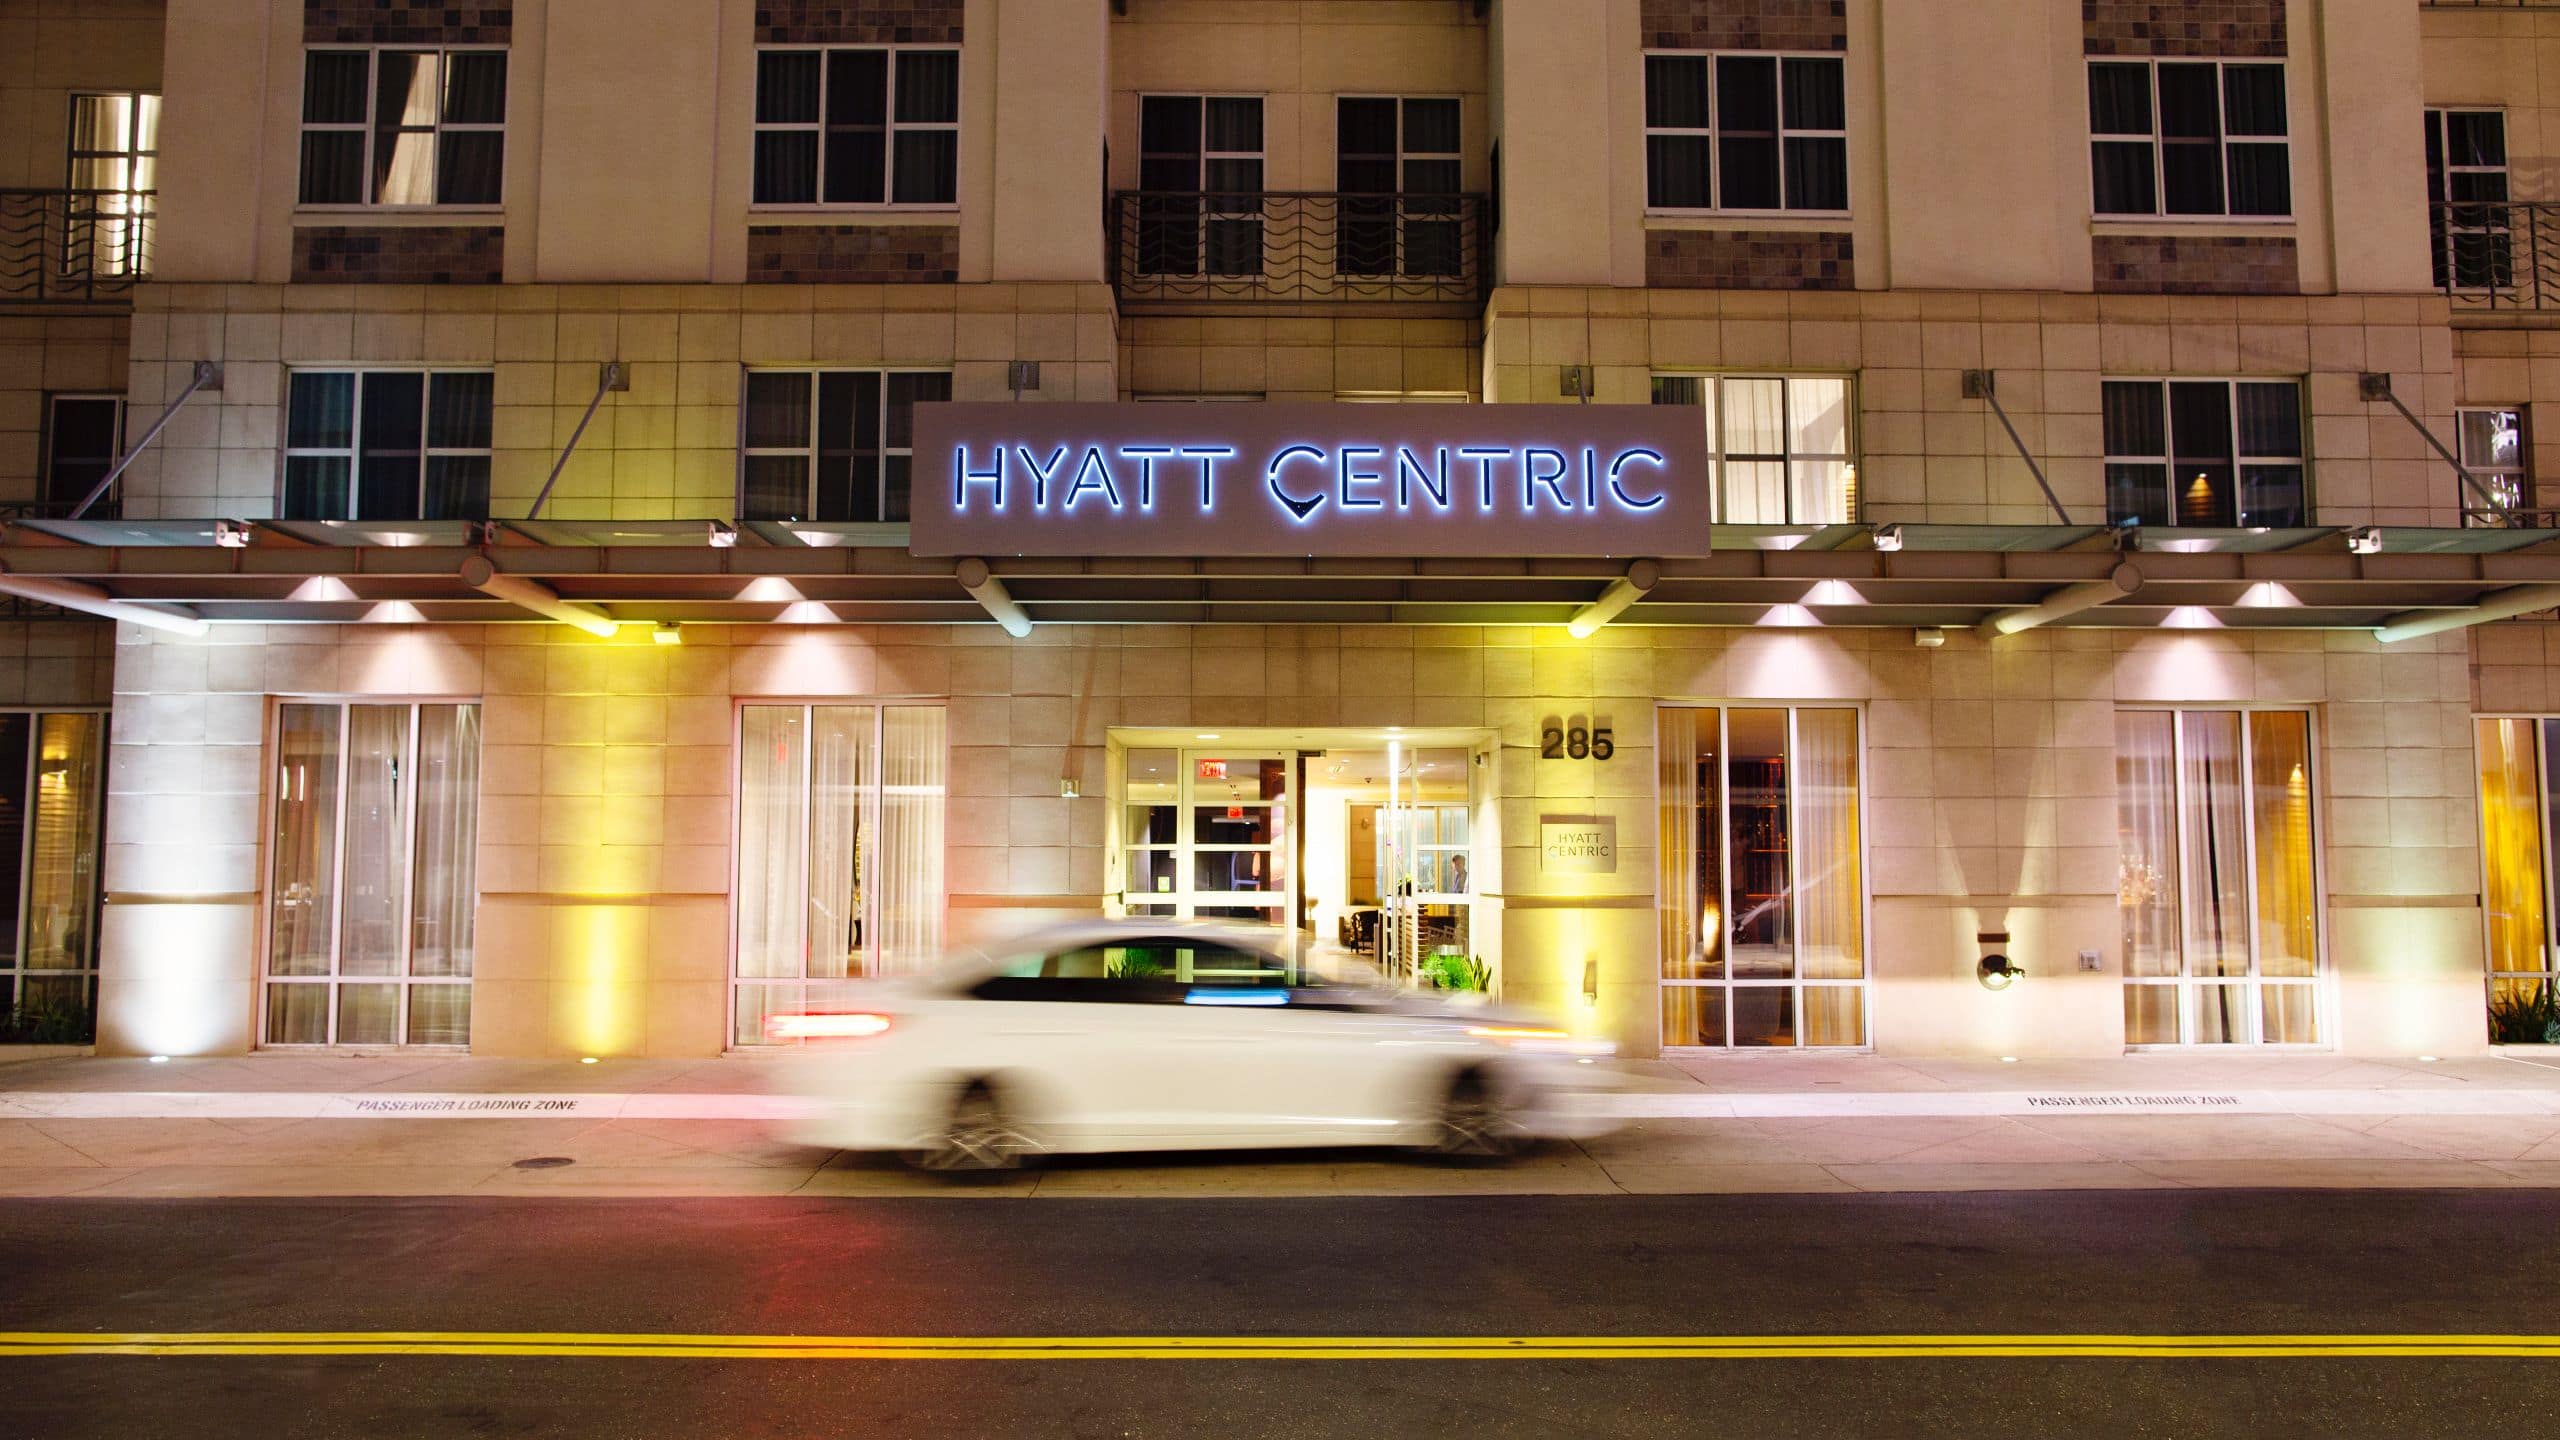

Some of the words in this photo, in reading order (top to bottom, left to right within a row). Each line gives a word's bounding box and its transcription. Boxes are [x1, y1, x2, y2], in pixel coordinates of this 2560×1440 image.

[953, 446, 1235, 510] HYATT
[1266, 445, 1668, 521] CENTRIC
[1541, 727, 1614, 760] 285
[1558, 833, 1602, 844] HYATT
[1548, 846, 1609, 858] CENTRIC
[356, 1100, 455, 1110] PASSENGER
[457, 1100, 530, 1110] LOADING
[533, 1100, 578, 1110] ZONE
[2027, 1096, 2122, 1106] PASSENGER
[2124, 1096, 2195, 1105] LOADING
[2197, 1095, 2240, 1105] ZONE
